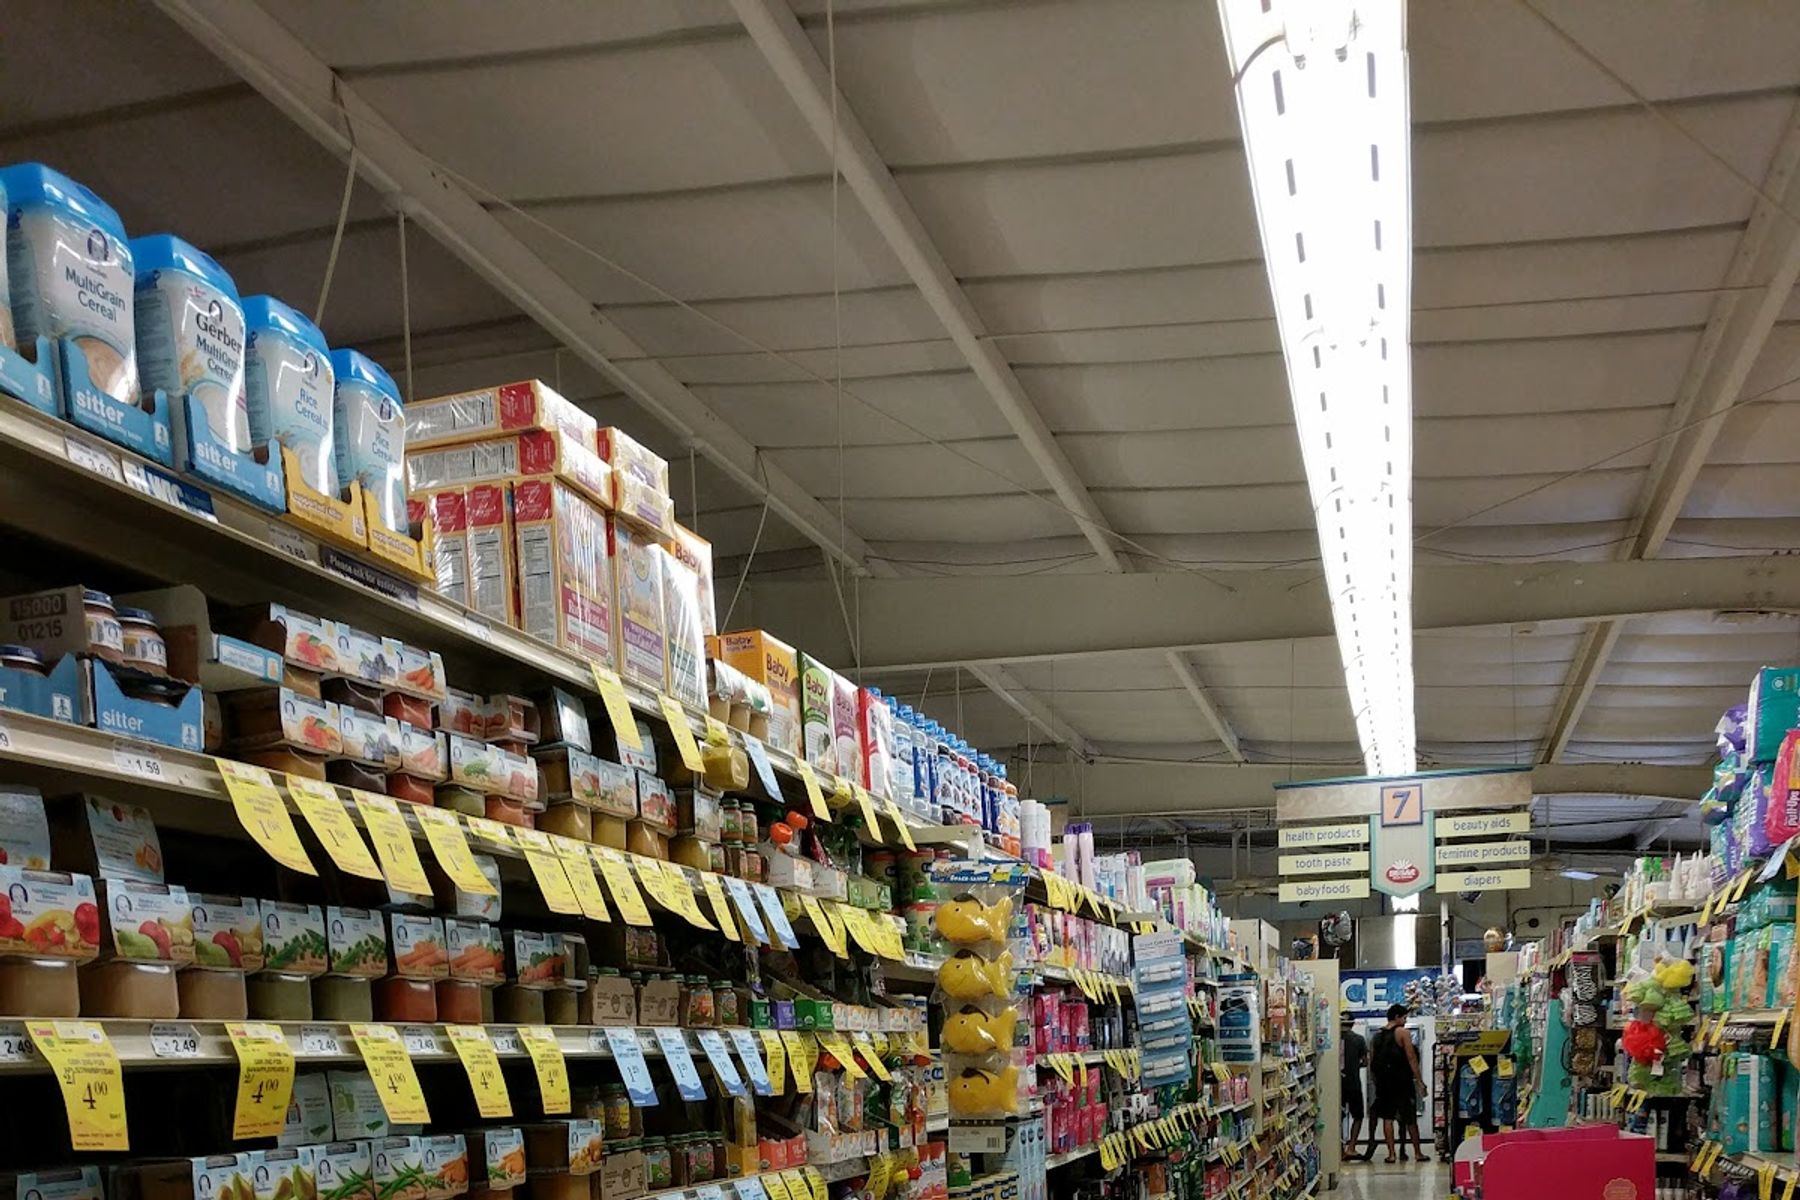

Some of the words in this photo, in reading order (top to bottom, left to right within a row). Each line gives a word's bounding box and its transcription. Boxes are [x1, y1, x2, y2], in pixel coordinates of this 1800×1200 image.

[64, 266, 126, 309] MultiGrain
[78, 289, 118, 323] Cereal
[195, 312, 243, 353] Gerber
[75, 389, 125, 425] sitter
[299, 387, 318, 411] Rice
[295, 401, 324, 426] Cereal
[195, 441, 238, 473] sitter
[766, 652, 789, 683] Baby
[805, 672, 827, 700] Baby
[103, 709, 144, 732] sitter
[1392, 790, 1411, 819] 7
[1285, 831, 1315, 843] health
[1317, 828, 1361, 841] products
[1453, 820, 1488, 832] beauty
[1490, 818, 1511, 829] aids
[1295, 857, 1323, 868] tooth
[1324, 857, 1352, 869] paste
[1438, 848, 1479, 860] feminine
[1481, 845, 1528, 858] products
[1463, 876, 1501, 887] diapers
[4, 1039, 33, 1055] 2.49
[173, 1039, 197, 1053] 2.49
[318, 1039, 338, 1053] 2.49
